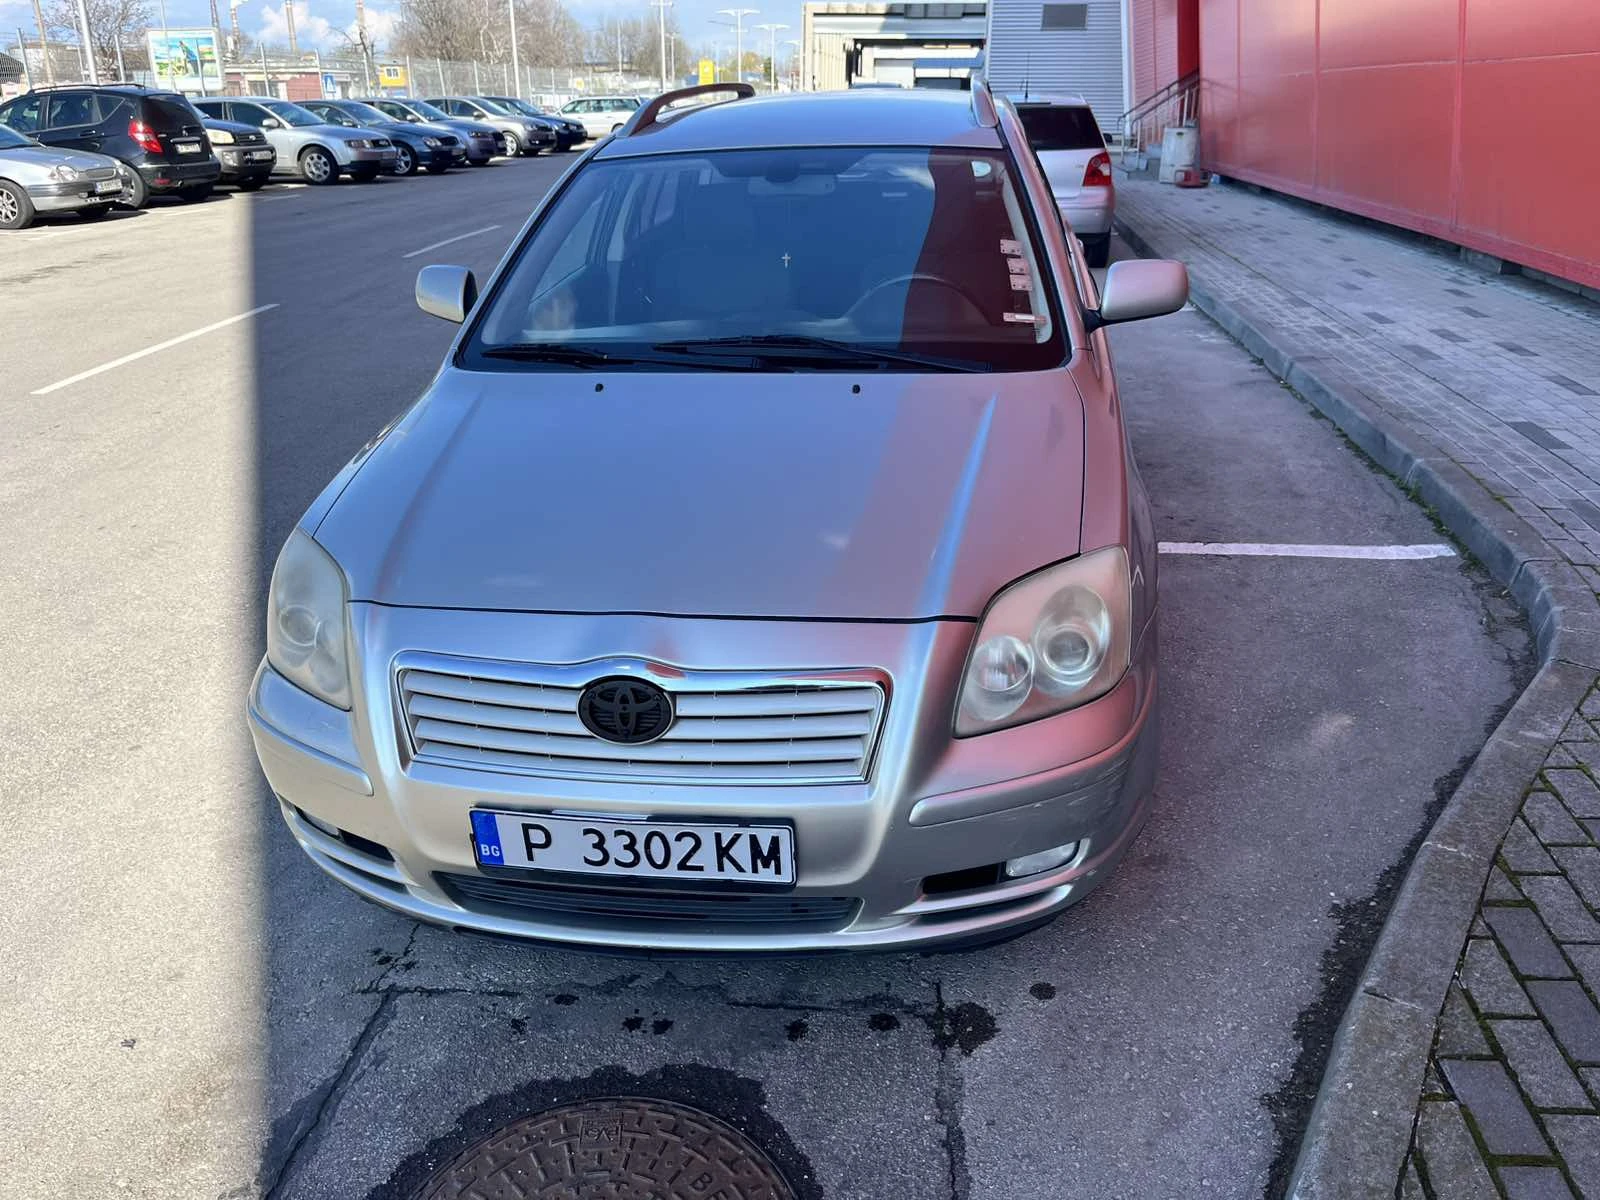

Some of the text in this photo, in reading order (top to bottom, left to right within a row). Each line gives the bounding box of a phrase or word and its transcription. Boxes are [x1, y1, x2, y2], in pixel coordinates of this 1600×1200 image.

[480, 843, 500, 857] BG
[520, 822, 782, 876] P 3302KM
